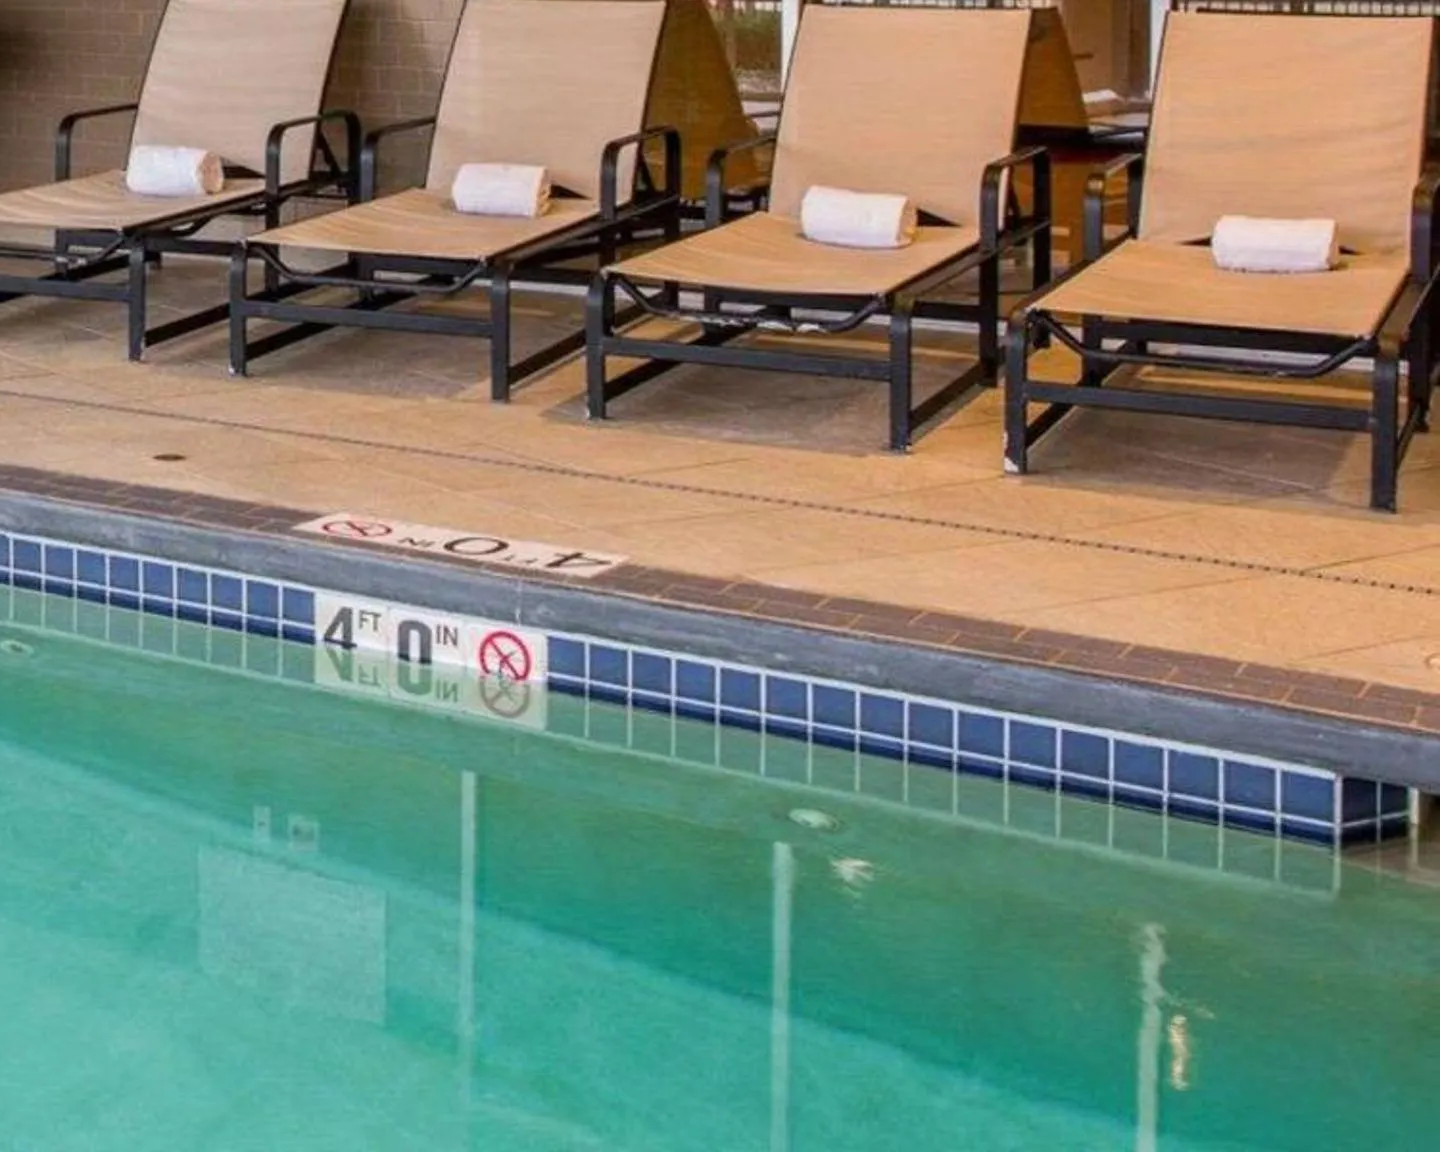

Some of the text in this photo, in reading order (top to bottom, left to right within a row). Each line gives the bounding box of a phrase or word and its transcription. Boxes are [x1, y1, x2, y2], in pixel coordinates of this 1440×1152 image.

[324, 606, 458, 665] 4 FT 0 IN
